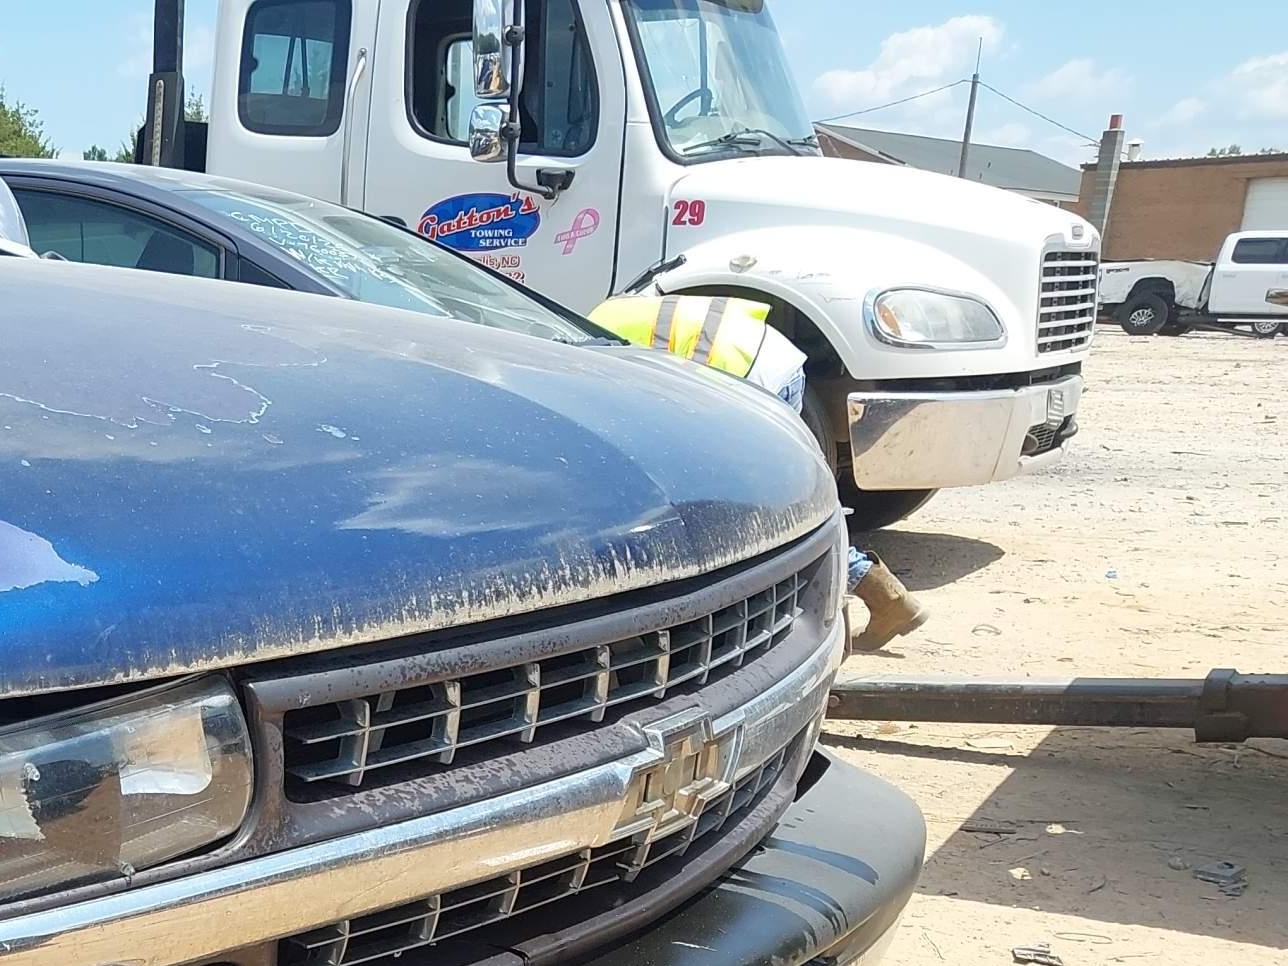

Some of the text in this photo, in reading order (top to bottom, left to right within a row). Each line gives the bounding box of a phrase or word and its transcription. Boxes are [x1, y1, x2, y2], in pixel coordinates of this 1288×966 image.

[417, 191, 538, 240] Gatton's
[672, 200, 705, 225] 29
[471, 228, 513, 238] TOWING
[479, 238, 527, 247] SERVICE
